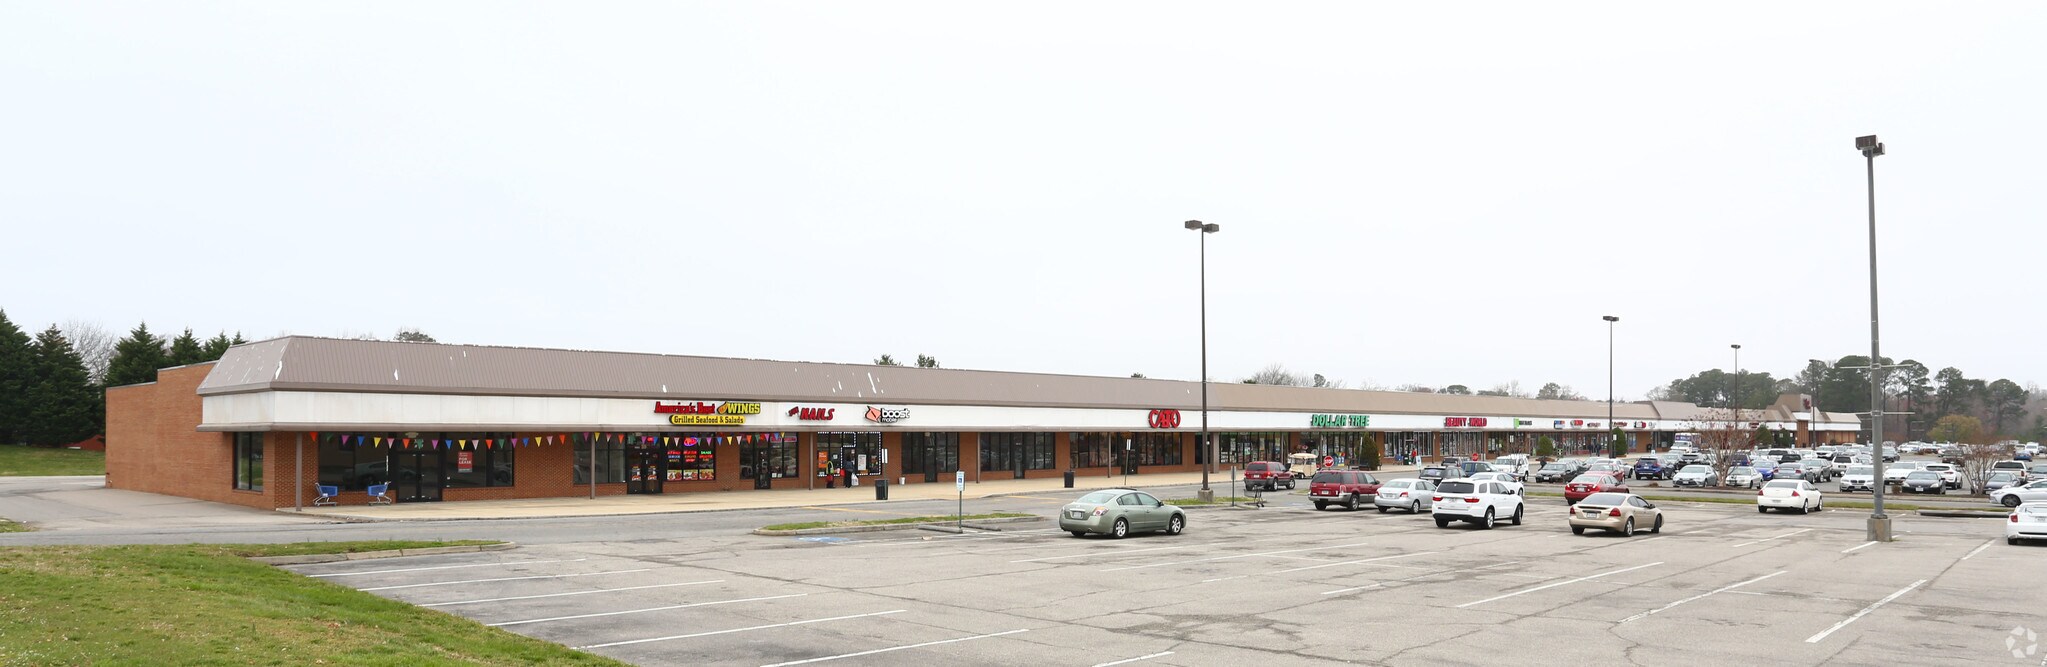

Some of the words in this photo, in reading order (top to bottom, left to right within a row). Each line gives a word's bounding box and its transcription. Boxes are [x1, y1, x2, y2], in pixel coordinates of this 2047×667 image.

[654, 401, 696, 414] America's
[697, 402, 716, 414] Best
[728, 402, 760, 414] WINGS
[800, 407, 835, 420] NAILS
[881, 407, 910, 418] boost
[674, 415, 694, 424] Grilled
[696, 415, 719, 424] Seafood
[725, 415, 744, 424] Salads
[1148, 409, 1181, 428] CATO
[1311, 414, 1347, 427] DOLLAR
[1348, 415, 1370, 427] TREE
[1444, 417, 1467, 427] BEAUTY
[1468, 417, 1487, 427] WORLD
